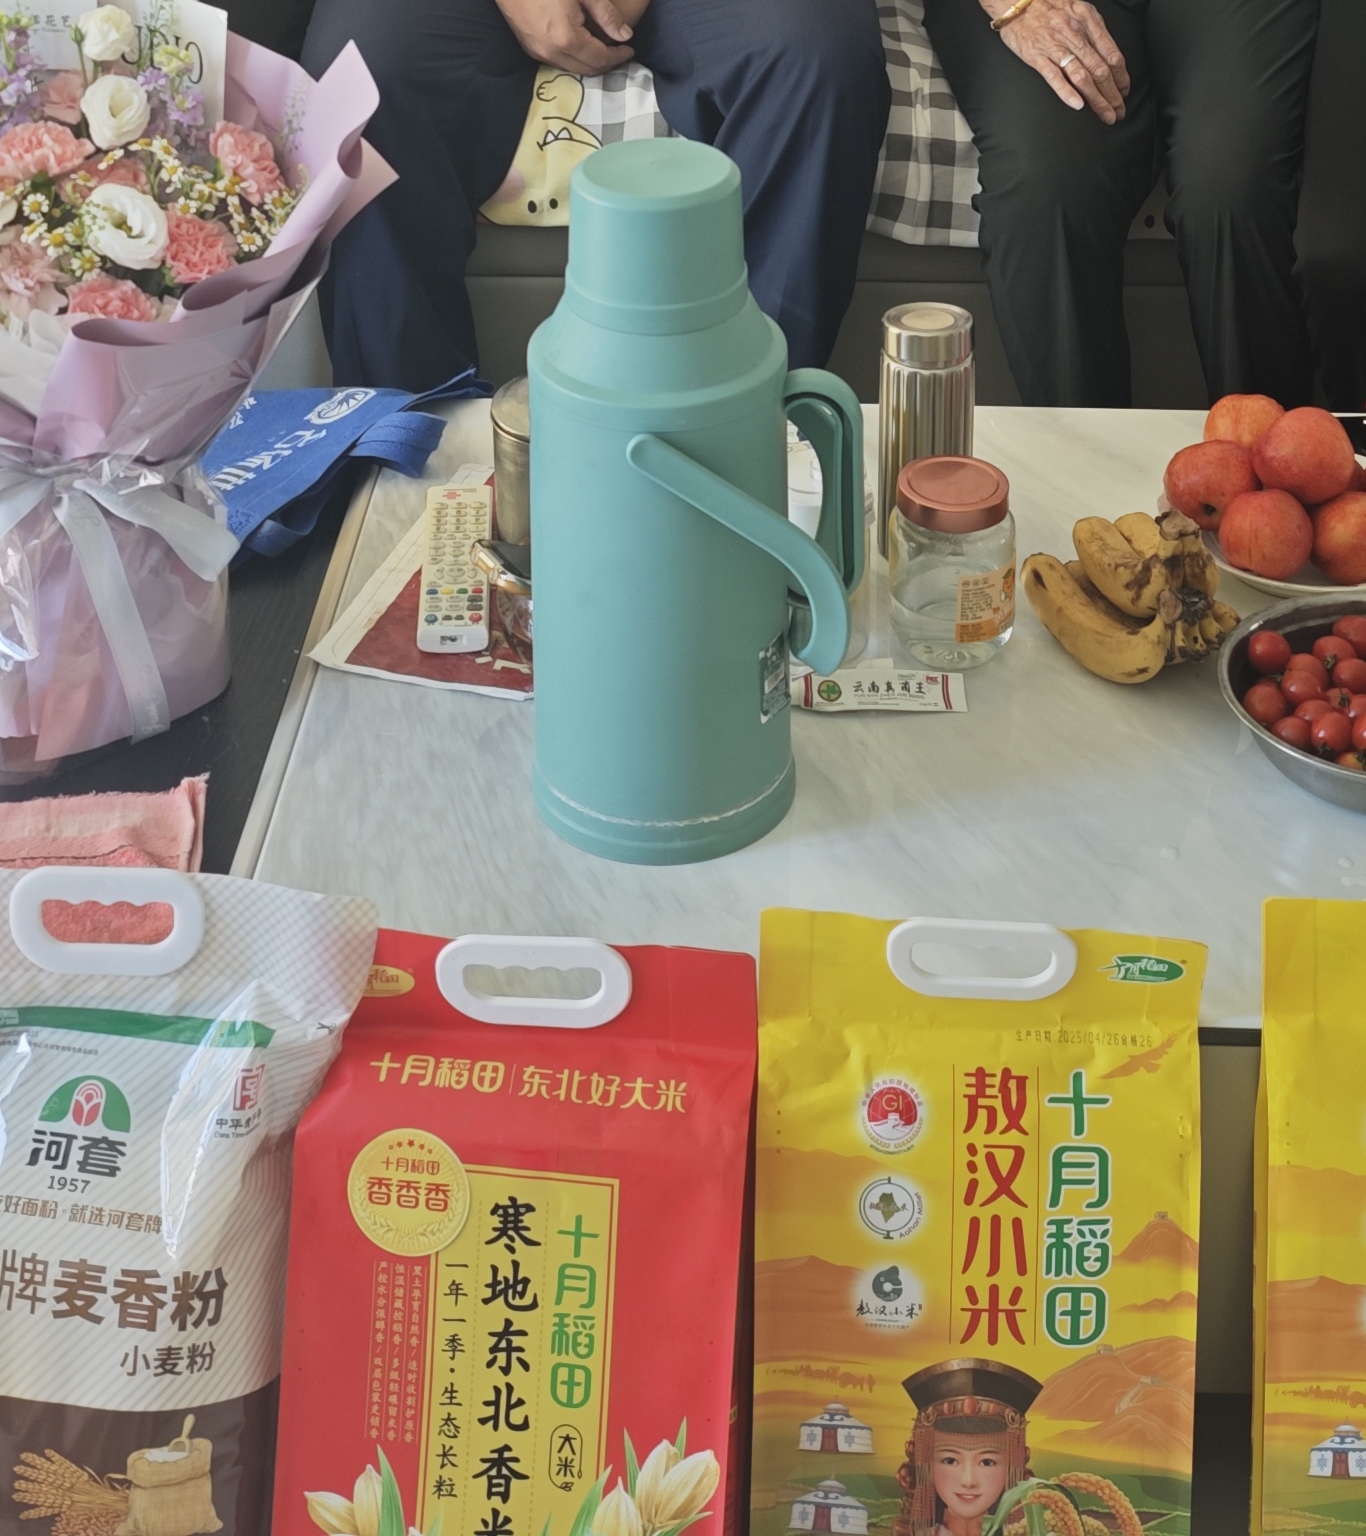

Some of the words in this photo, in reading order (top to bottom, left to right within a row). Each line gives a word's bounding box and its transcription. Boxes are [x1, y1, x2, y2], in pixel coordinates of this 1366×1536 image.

[369, 1051, 507, 1094] 十月稻田
[517, 1064, 688, 1114] 东北好大米
[882, 1094, 902, 1111] GI
[25, 1129, 127, 1178] 河套
[380, 1155, 441, 1176] 十月稻田
[47, 1175, 91, 1195] 1957
[366, 1175, 452, 1213] 香香香
[960, 1066, 1029, 1347] 敖汉小米
[1044, 1070, 1110, 1346] 十月稻田
[550, 1214, 600, 1409] 十月稻田
[120, 1341, 216, 1378] 小麦粉
[555, 1433, 578, 1480] 大米
